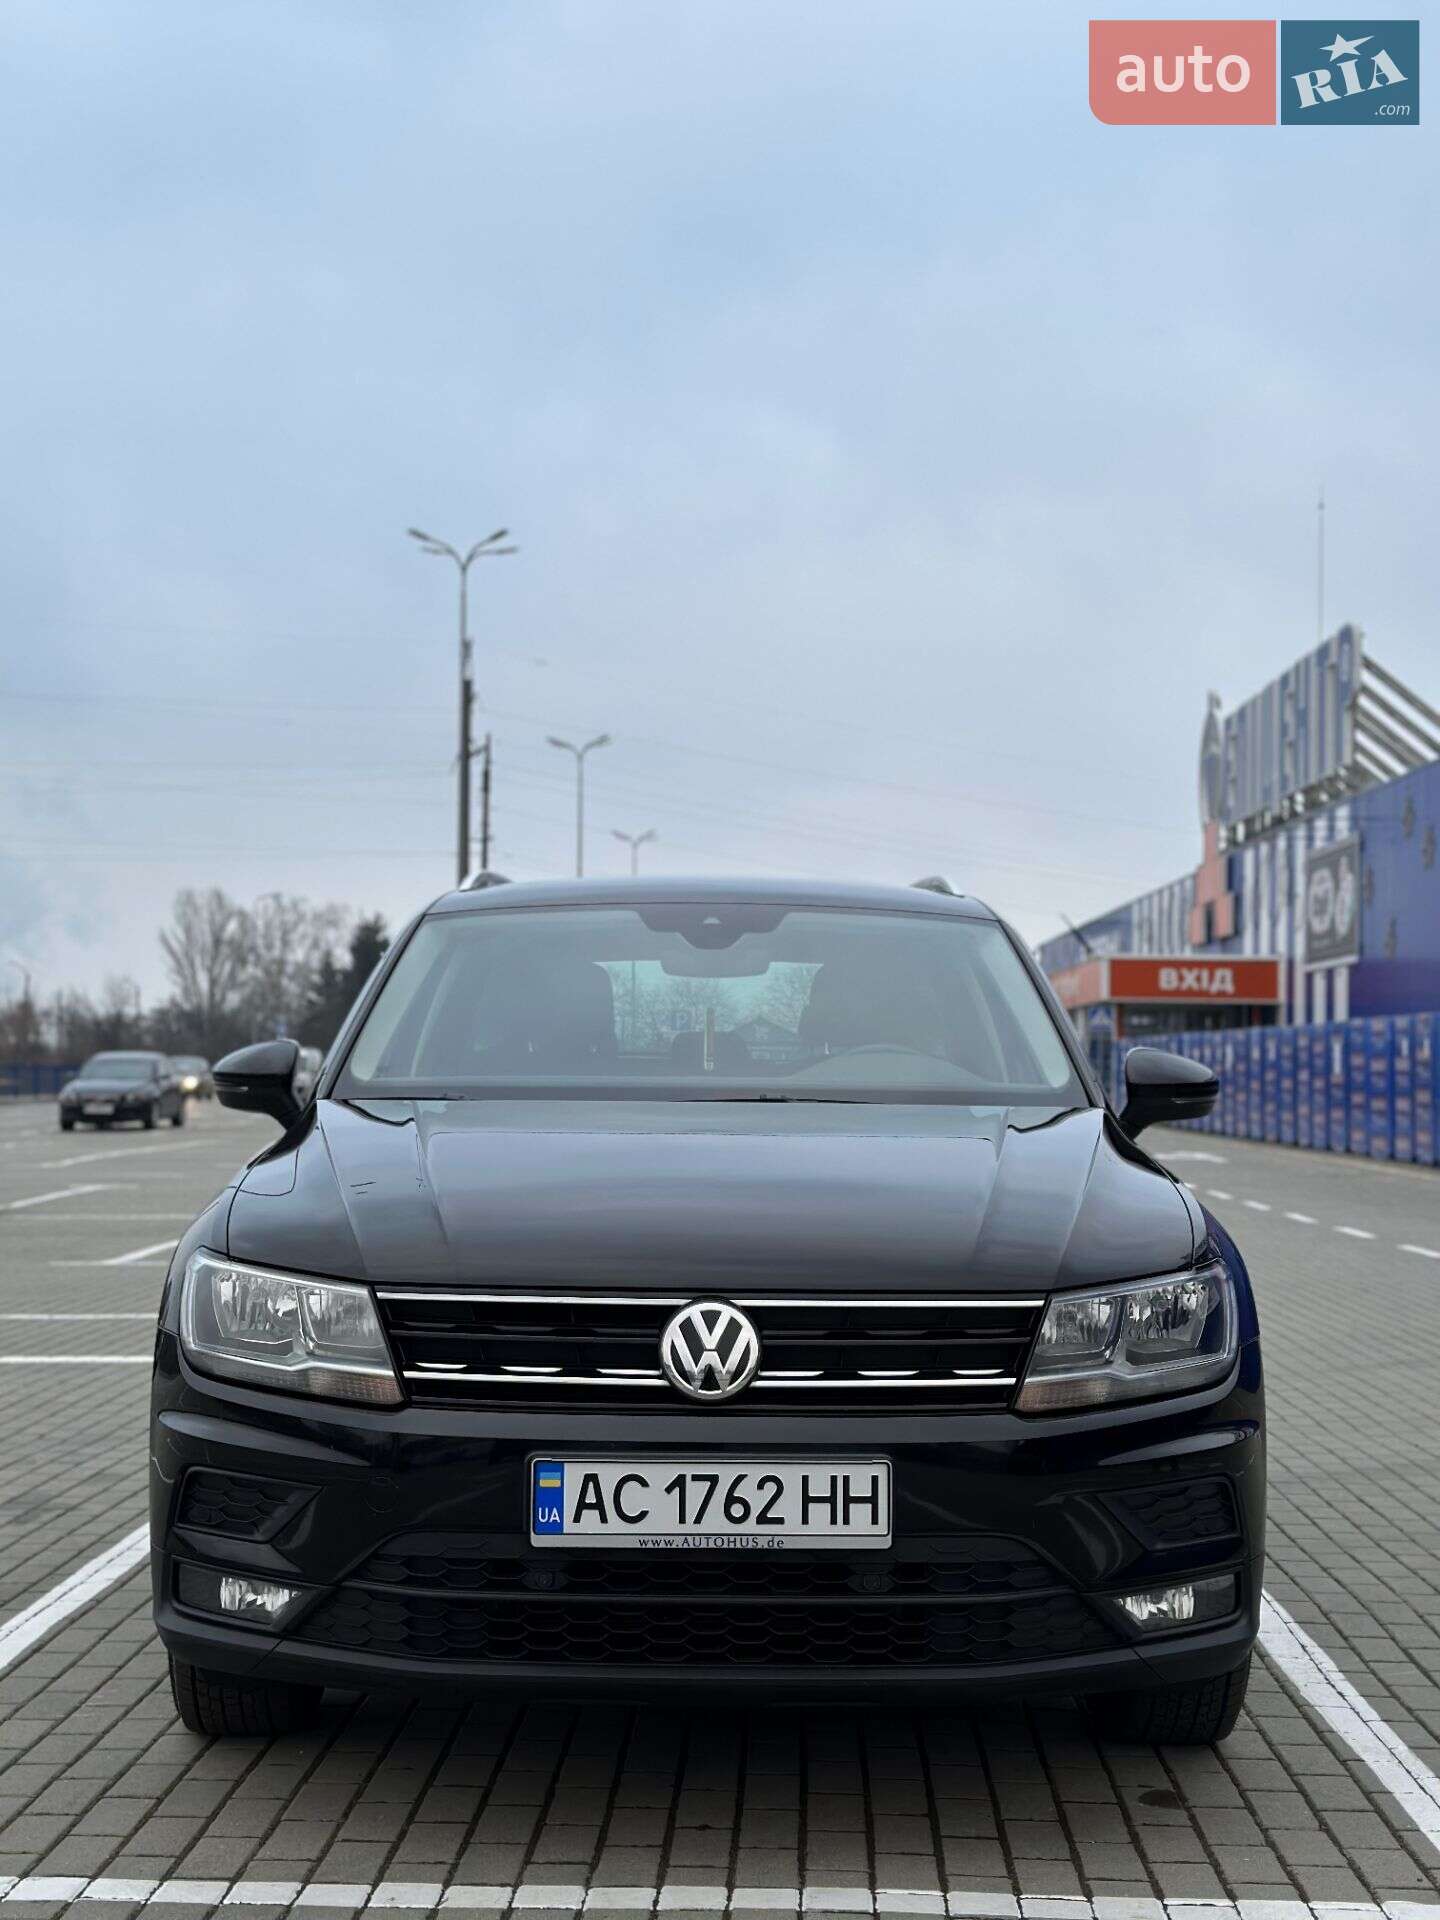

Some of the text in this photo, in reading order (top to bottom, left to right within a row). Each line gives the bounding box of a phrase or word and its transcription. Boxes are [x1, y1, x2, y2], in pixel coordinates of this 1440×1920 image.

[1157, 966, 1236, 996] ВХІД
[572, 1472, 880, 1526] AC 1762 HH
[538, 1507, 561, 1523] UA
[638, 1536, 786, 1549] www.AUTOHUS.de
